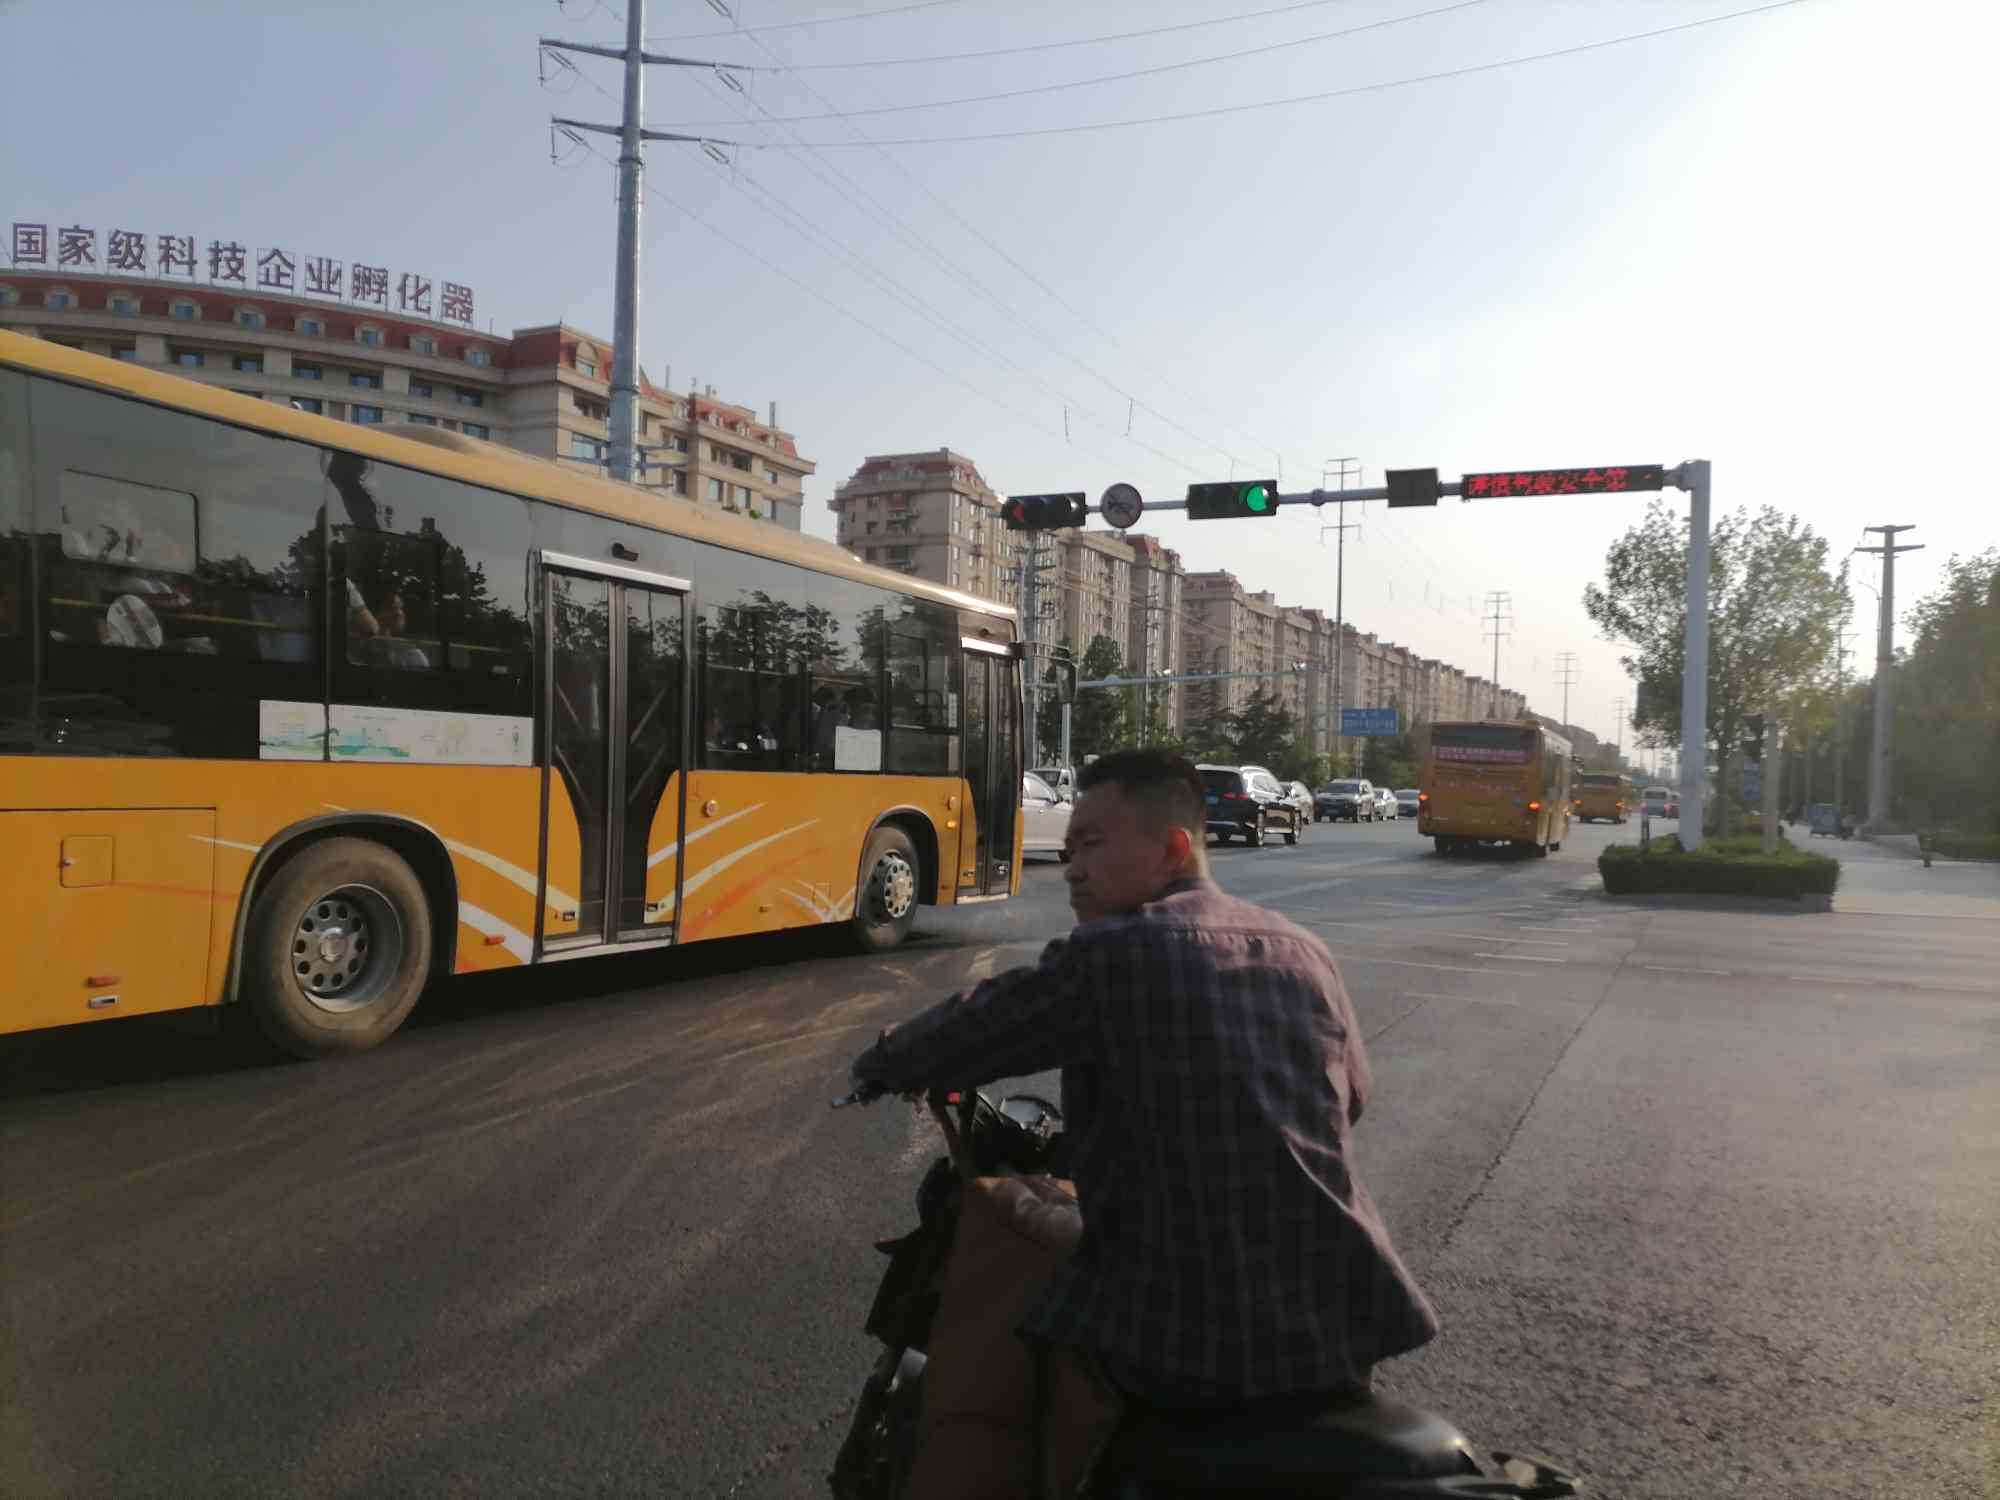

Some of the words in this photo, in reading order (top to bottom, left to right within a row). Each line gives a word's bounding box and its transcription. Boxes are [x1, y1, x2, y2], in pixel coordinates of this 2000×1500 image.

[13, 223, 474, 323] 国家级科技企业孵化器
